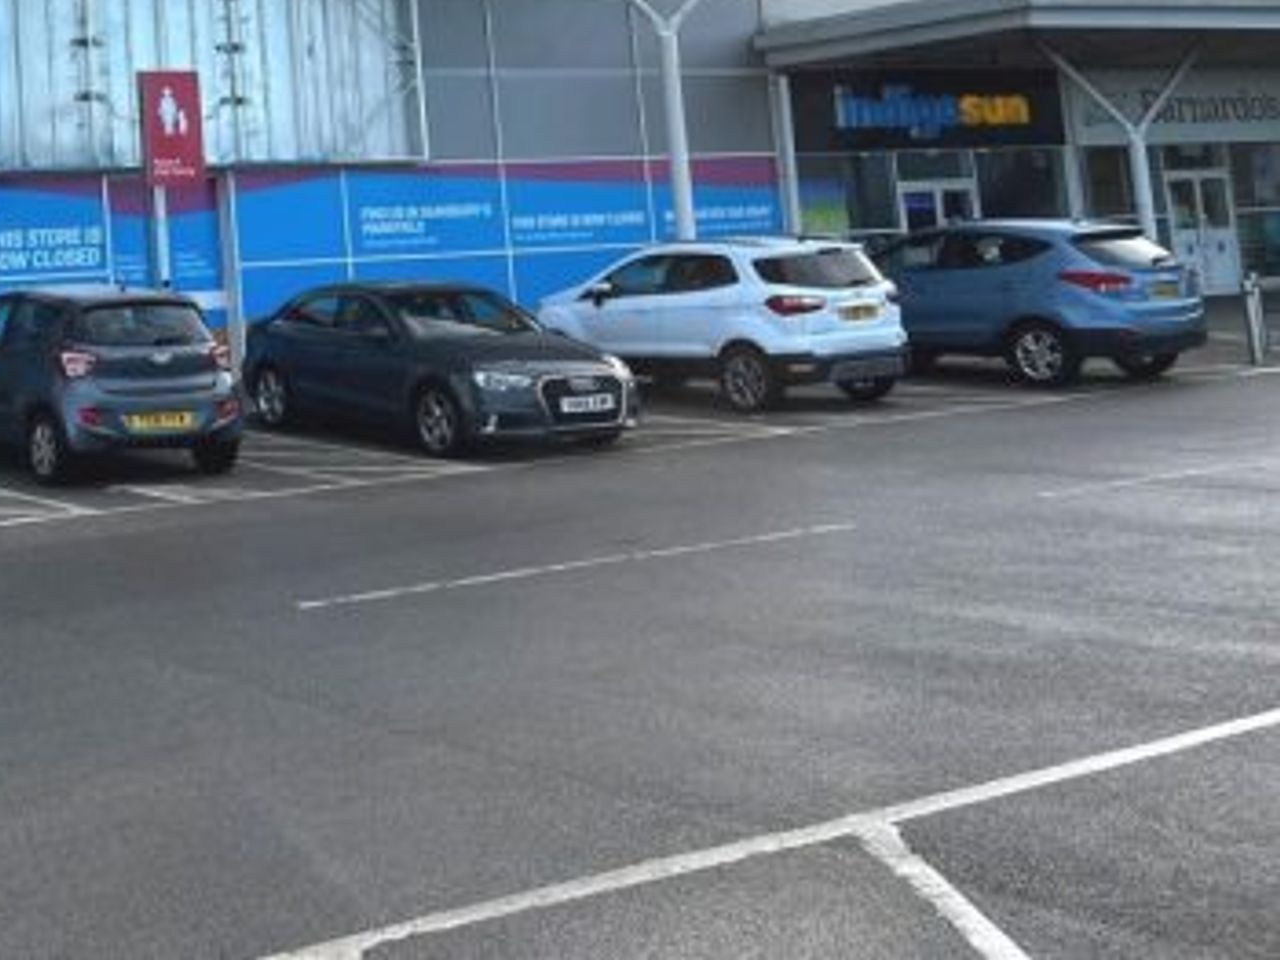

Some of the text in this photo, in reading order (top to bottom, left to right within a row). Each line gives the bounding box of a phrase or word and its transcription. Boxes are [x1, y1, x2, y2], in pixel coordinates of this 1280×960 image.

[26, 227, 81, 247] STORE
[83, 225, 102, 245] IS
[32, 247, 100, 267] CLOSED
